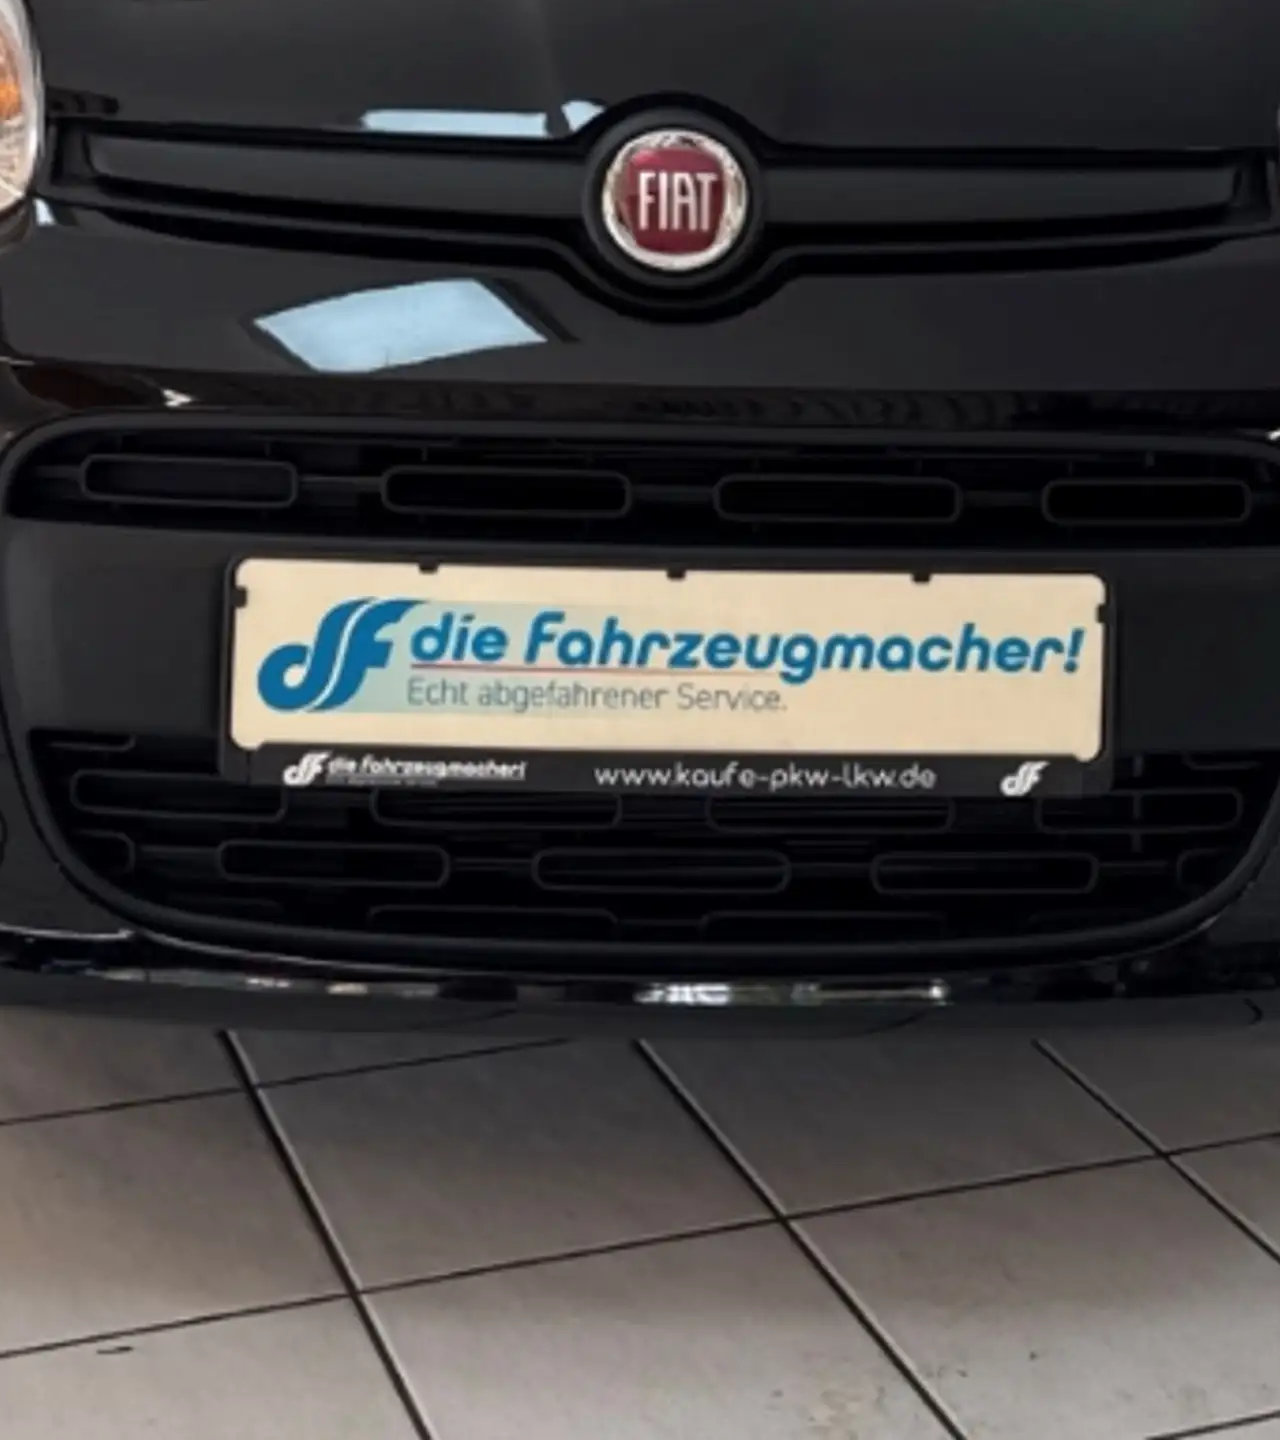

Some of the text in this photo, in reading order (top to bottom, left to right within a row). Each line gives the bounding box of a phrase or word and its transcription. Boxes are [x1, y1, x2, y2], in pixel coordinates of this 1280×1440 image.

[639, 172, 718, 231] FIAT
[410, 611, 508, 663] die
[523, 609, 1086, 686] Fahrzeugmacher!
[407, 675, 788, 714] Echt abgefahrener Service.
[593, 760, 938, 793] www.kaufe-pkw-lkw.de
